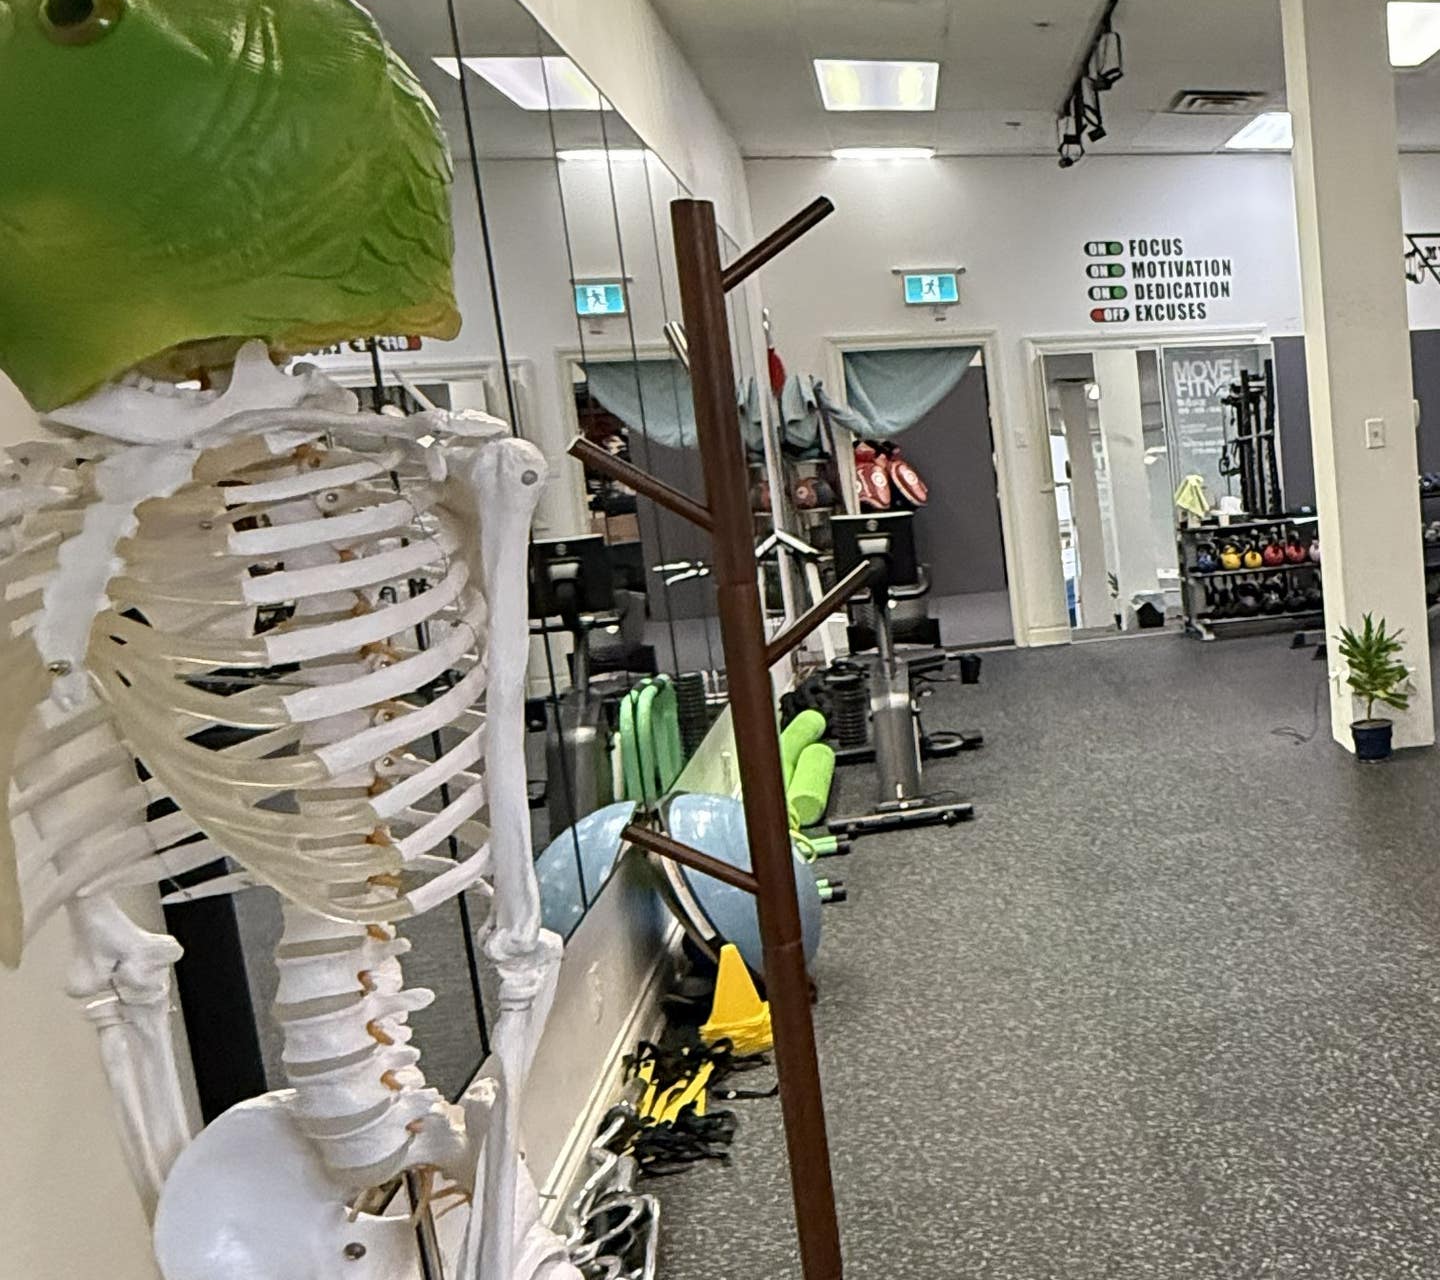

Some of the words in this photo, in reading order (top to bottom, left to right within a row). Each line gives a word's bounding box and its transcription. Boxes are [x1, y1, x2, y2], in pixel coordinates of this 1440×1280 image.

[1088, 243, 1107, 255] ON
[1129, 238, 1183, 257] FOCUS
[1090, 265, 1109, 278] ON
[1131, 259, 1232, 278] MOTIVATION
[1092, 287, 1111, 300] ON
[1134, 281, 1230, 300] DEDICATION
[1103, 308, 1126, 321] OFF
[1135, 302, 1207, 321] EXCUSES
